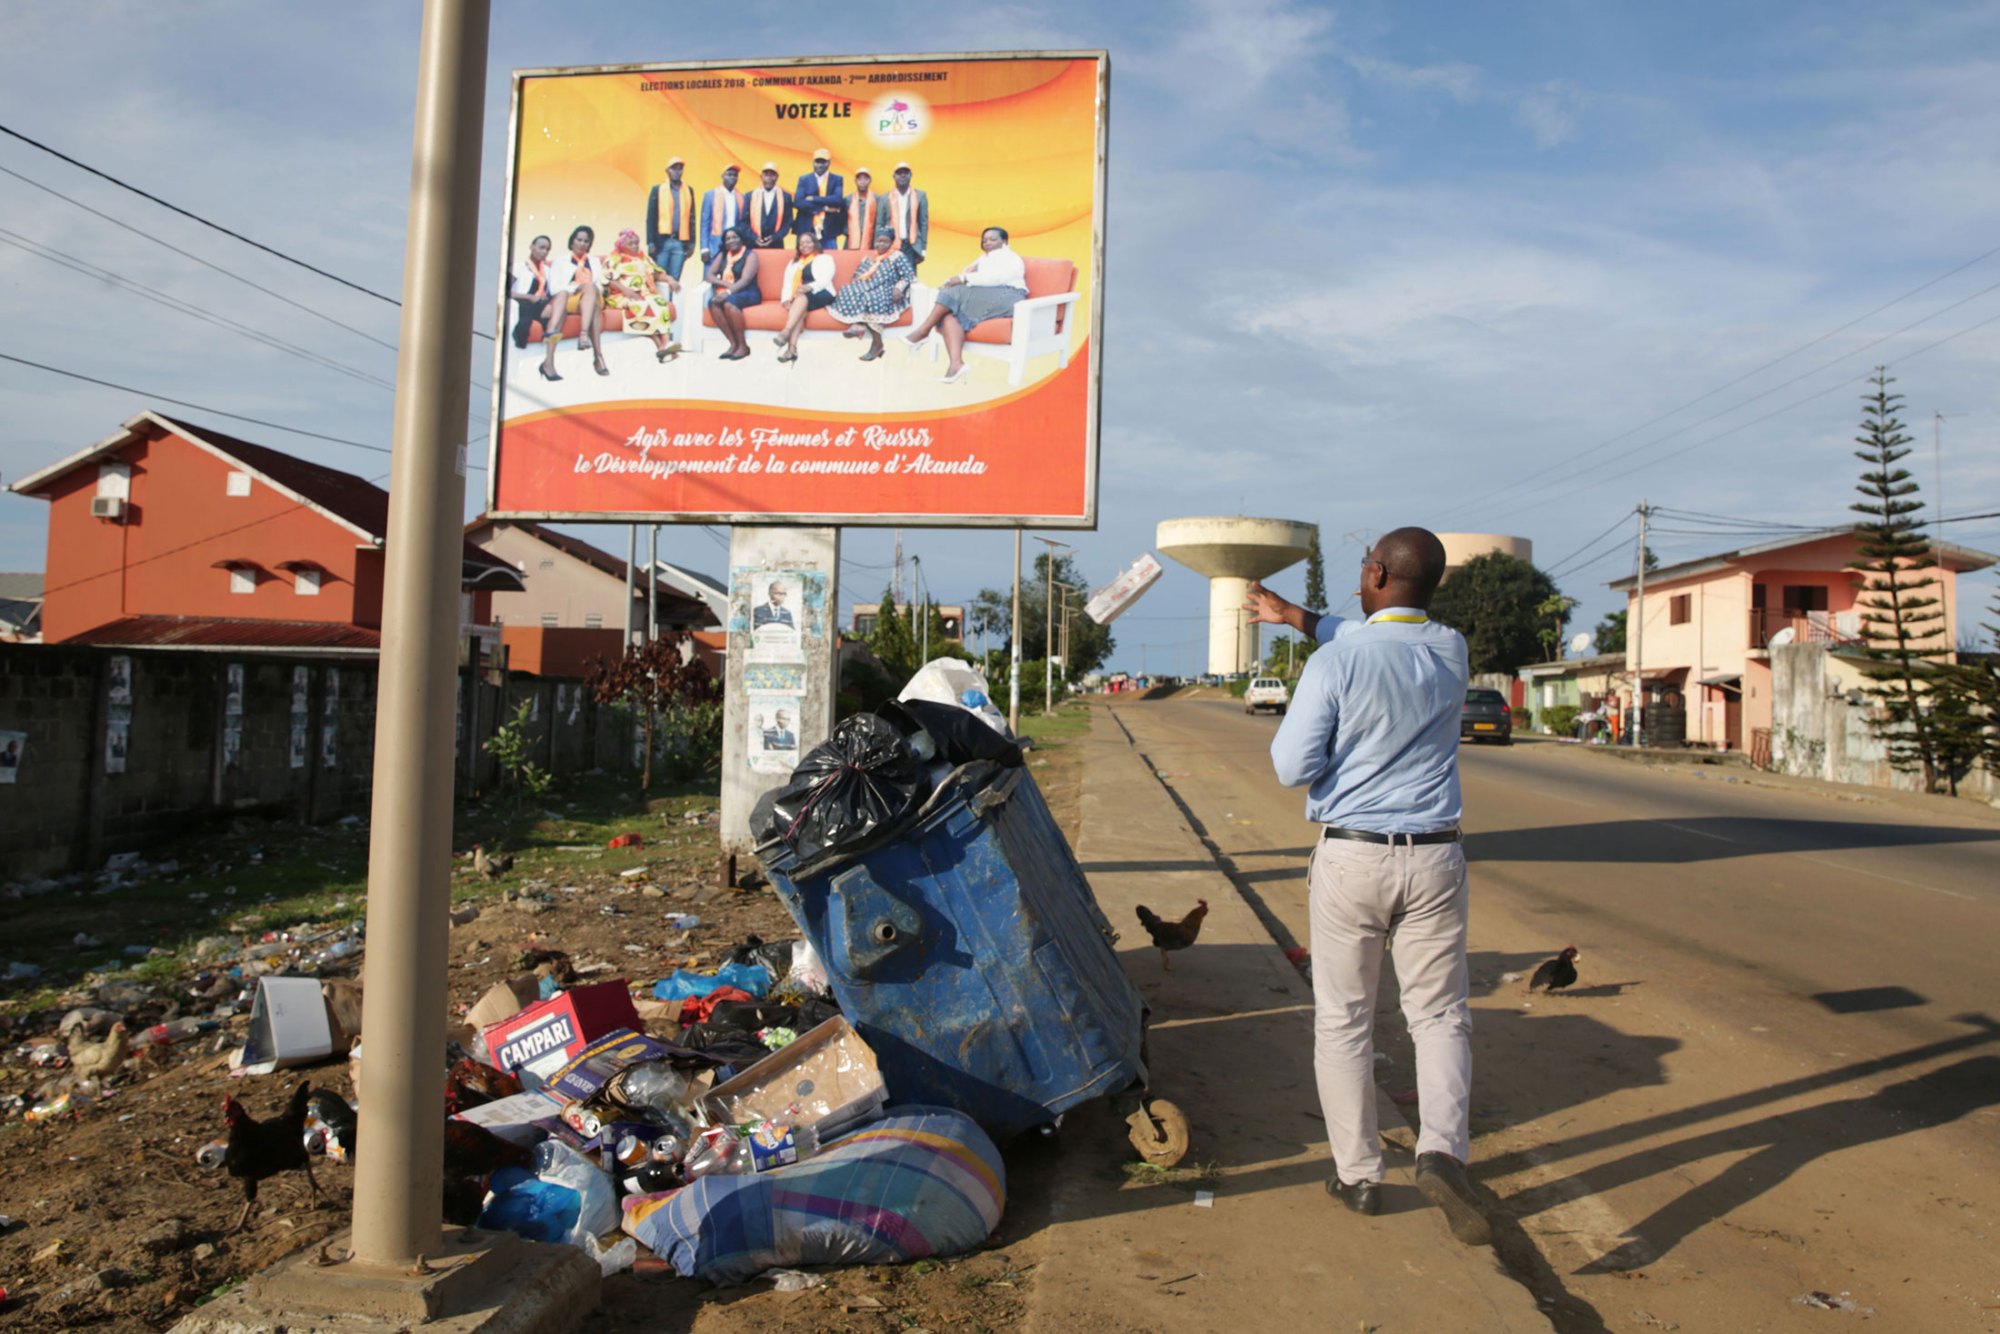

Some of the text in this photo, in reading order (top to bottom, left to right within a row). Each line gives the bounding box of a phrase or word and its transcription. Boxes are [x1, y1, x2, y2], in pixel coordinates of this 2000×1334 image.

[640, 81, 685, 92] ELECTIONS
[686, 79, 722, 90] LOCALES
[724, 78, 745, 88] 2018
[752, 77, 797, 87] COMMUNE
[798, 75, 842, 86] D'AKANDA
[868, 71, 948, 83] ARRONDISSEMENT
[775, 102, 852, 120] VOTEZ LE
[624, 424, 934, 457] Agir avec les Femmes et Réussir
[574, 452, 989, 480] le Développement de la commune d'Akanda
[500, 1018, 571, 1070] CAMPARI
